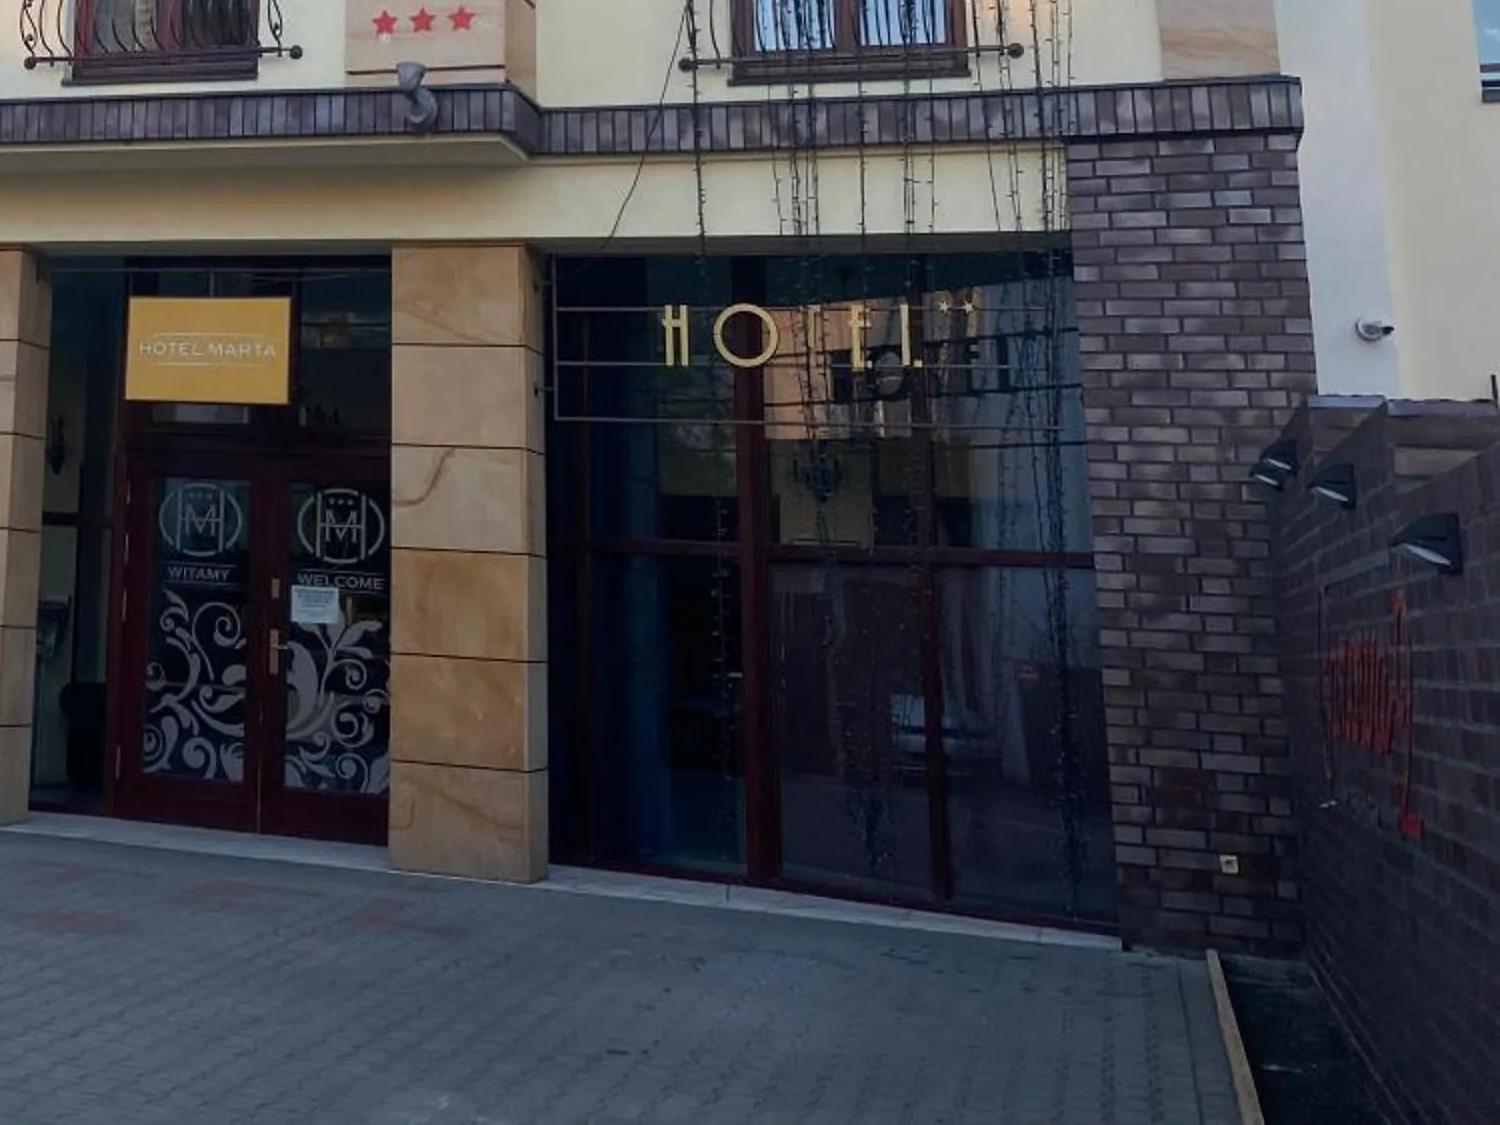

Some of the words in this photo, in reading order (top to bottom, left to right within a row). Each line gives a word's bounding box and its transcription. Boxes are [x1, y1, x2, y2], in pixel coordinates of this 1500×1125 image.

[138, 340, 204, 358] HOTEL
[207, 341, 277, 362] MARTA
[166, 565, 231, 582] WITAMY
[297, 572, 385, 591] WELCOME
